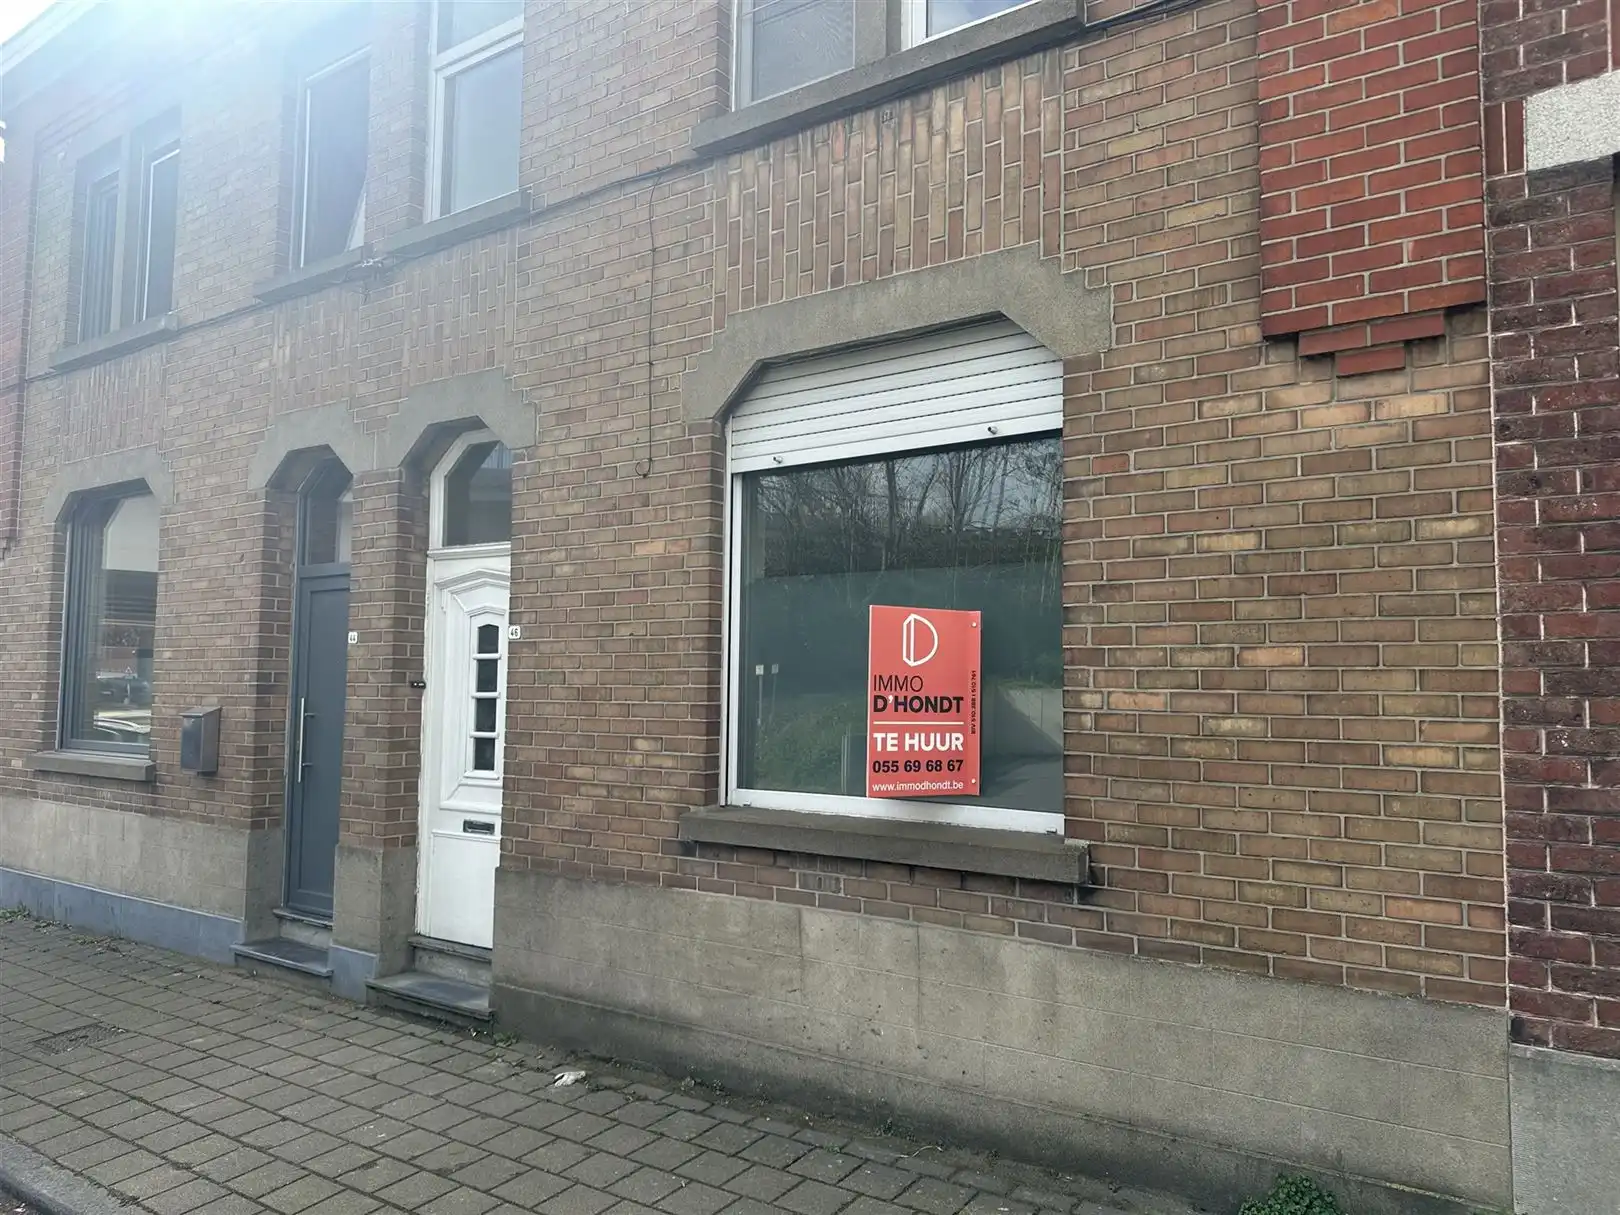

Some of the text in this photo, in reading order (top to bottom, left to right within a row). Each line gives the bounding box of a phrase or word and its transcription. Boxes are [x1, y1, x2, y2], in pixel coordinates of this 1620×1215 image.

[873, 674, 924, 693] IMMO
[873, 694, 964, 714] D'HONDT
[873, 732, 964, 752] TE HUUR
[872, 759, 964, 773] 055 69 68 67
[872, 780, 964, 792] www.immodhondt.be
